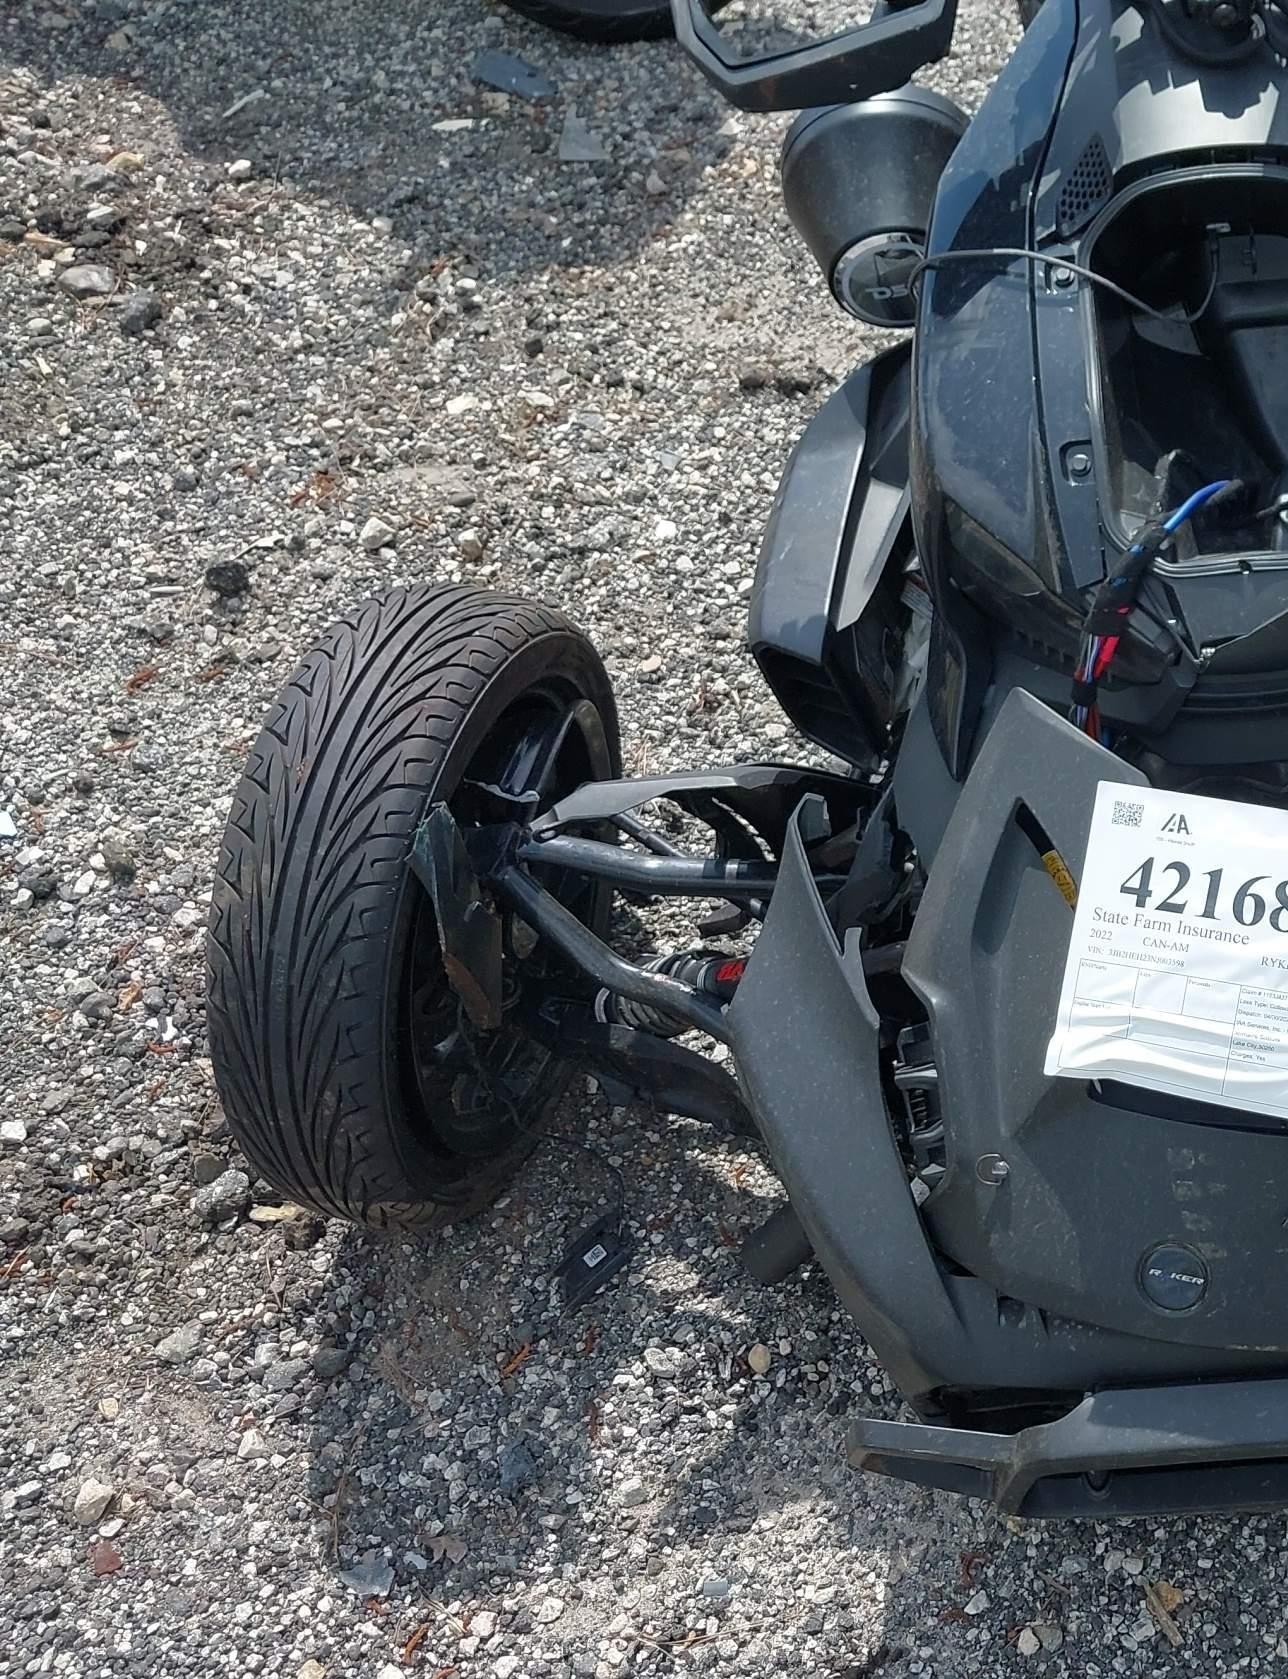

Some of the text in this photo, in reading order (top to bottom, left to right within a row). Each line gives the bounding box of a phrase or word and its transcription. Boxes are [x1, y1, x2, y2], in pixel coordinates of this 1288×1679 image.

[864, 284, 909, 300] DS
[1092, 906, 1250, 945] State Farm Insurance
[1089, 928, 1113, 941] 2022
[1142, 936, 1190, 953] CAN-AM
[1087, 945, 1104, 955] VIN:
[1149, 1268, 1204, 1285] RKER
